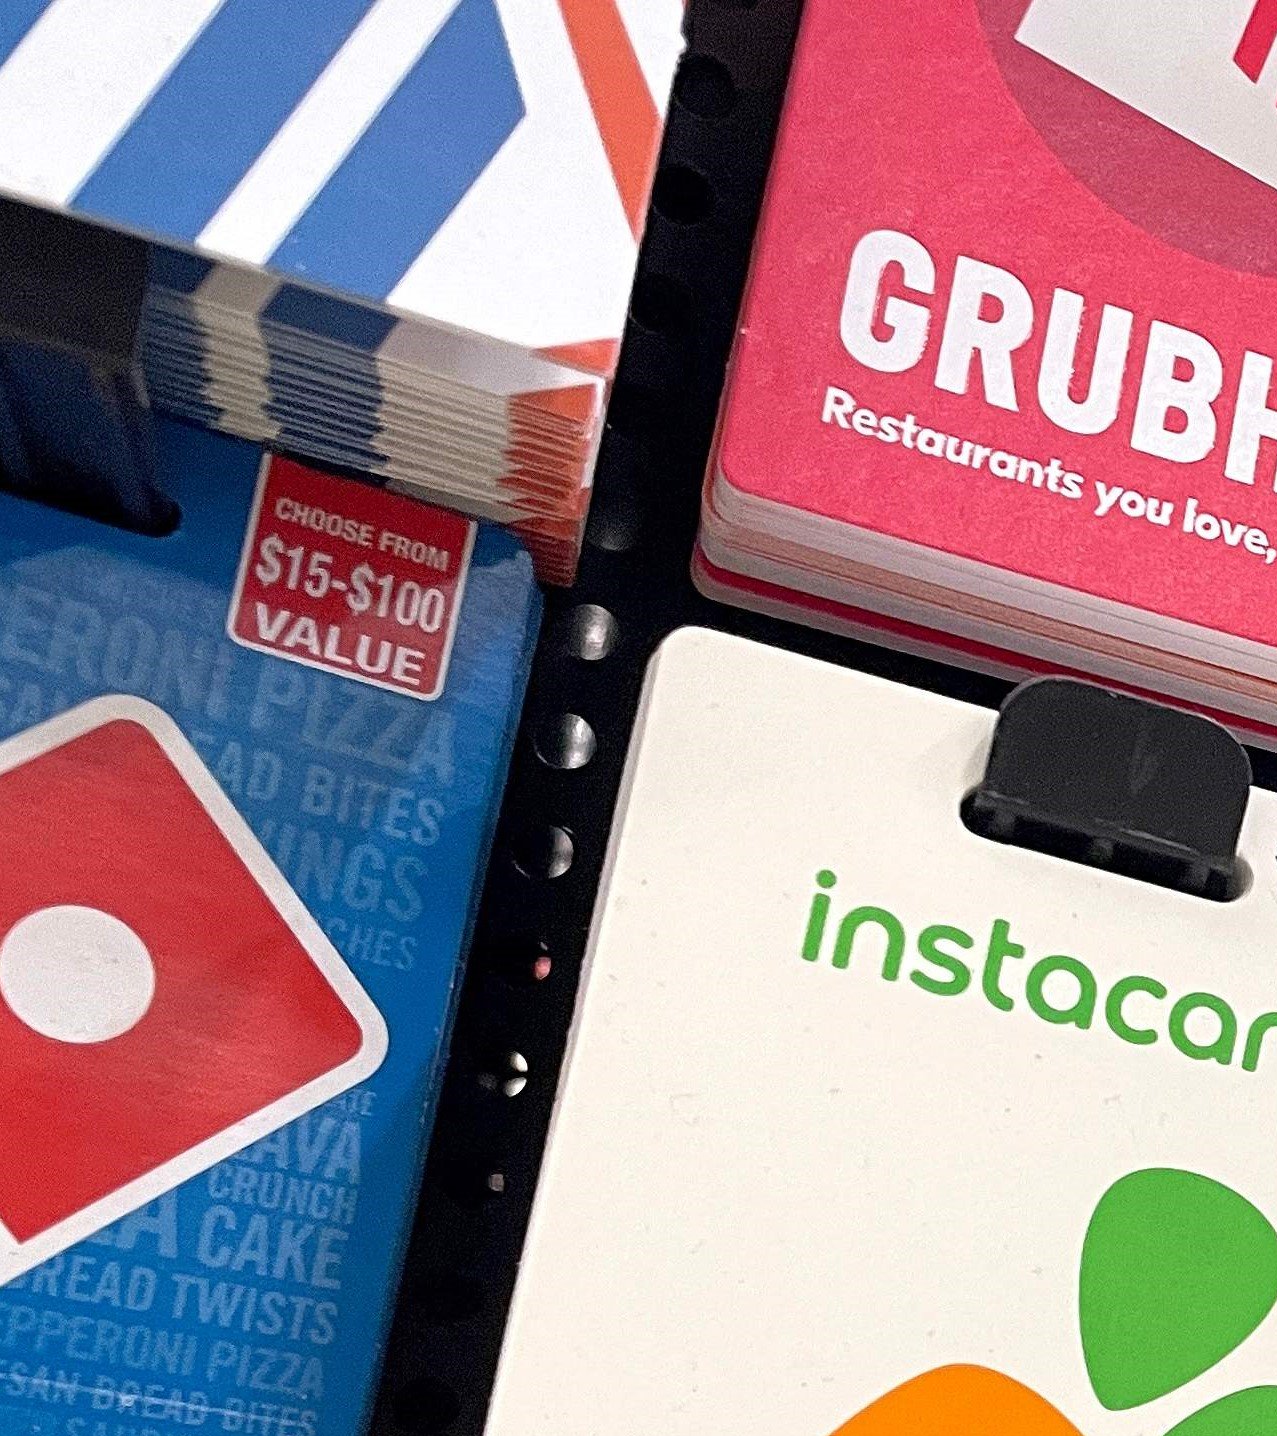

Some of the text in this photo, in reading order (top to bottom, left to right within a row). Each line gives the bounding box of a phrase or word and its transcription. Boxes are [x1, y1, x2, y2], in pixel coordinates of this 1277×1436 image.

[820, 384, 1084, 500] Restaurants
[1094, 477, 1172, 528] you
[1183, 496, 1277, 564] love,
[274, 497, 450, 572] CHOOSE FROM
[255, 532, 446, 635] $15-$100
[255, 601, 427, 687] VALUE
[300, 763, 446, 848] BITES
[207, 1162, 359, 1227] CRUNCH
[196, 1203, 351, 1291] CAKE
[169, 1271, 341, 1346] TWISTS
[91, 1373, 209, 1427] BREAD
[204, 1339, 326, 1401] PIZZA
